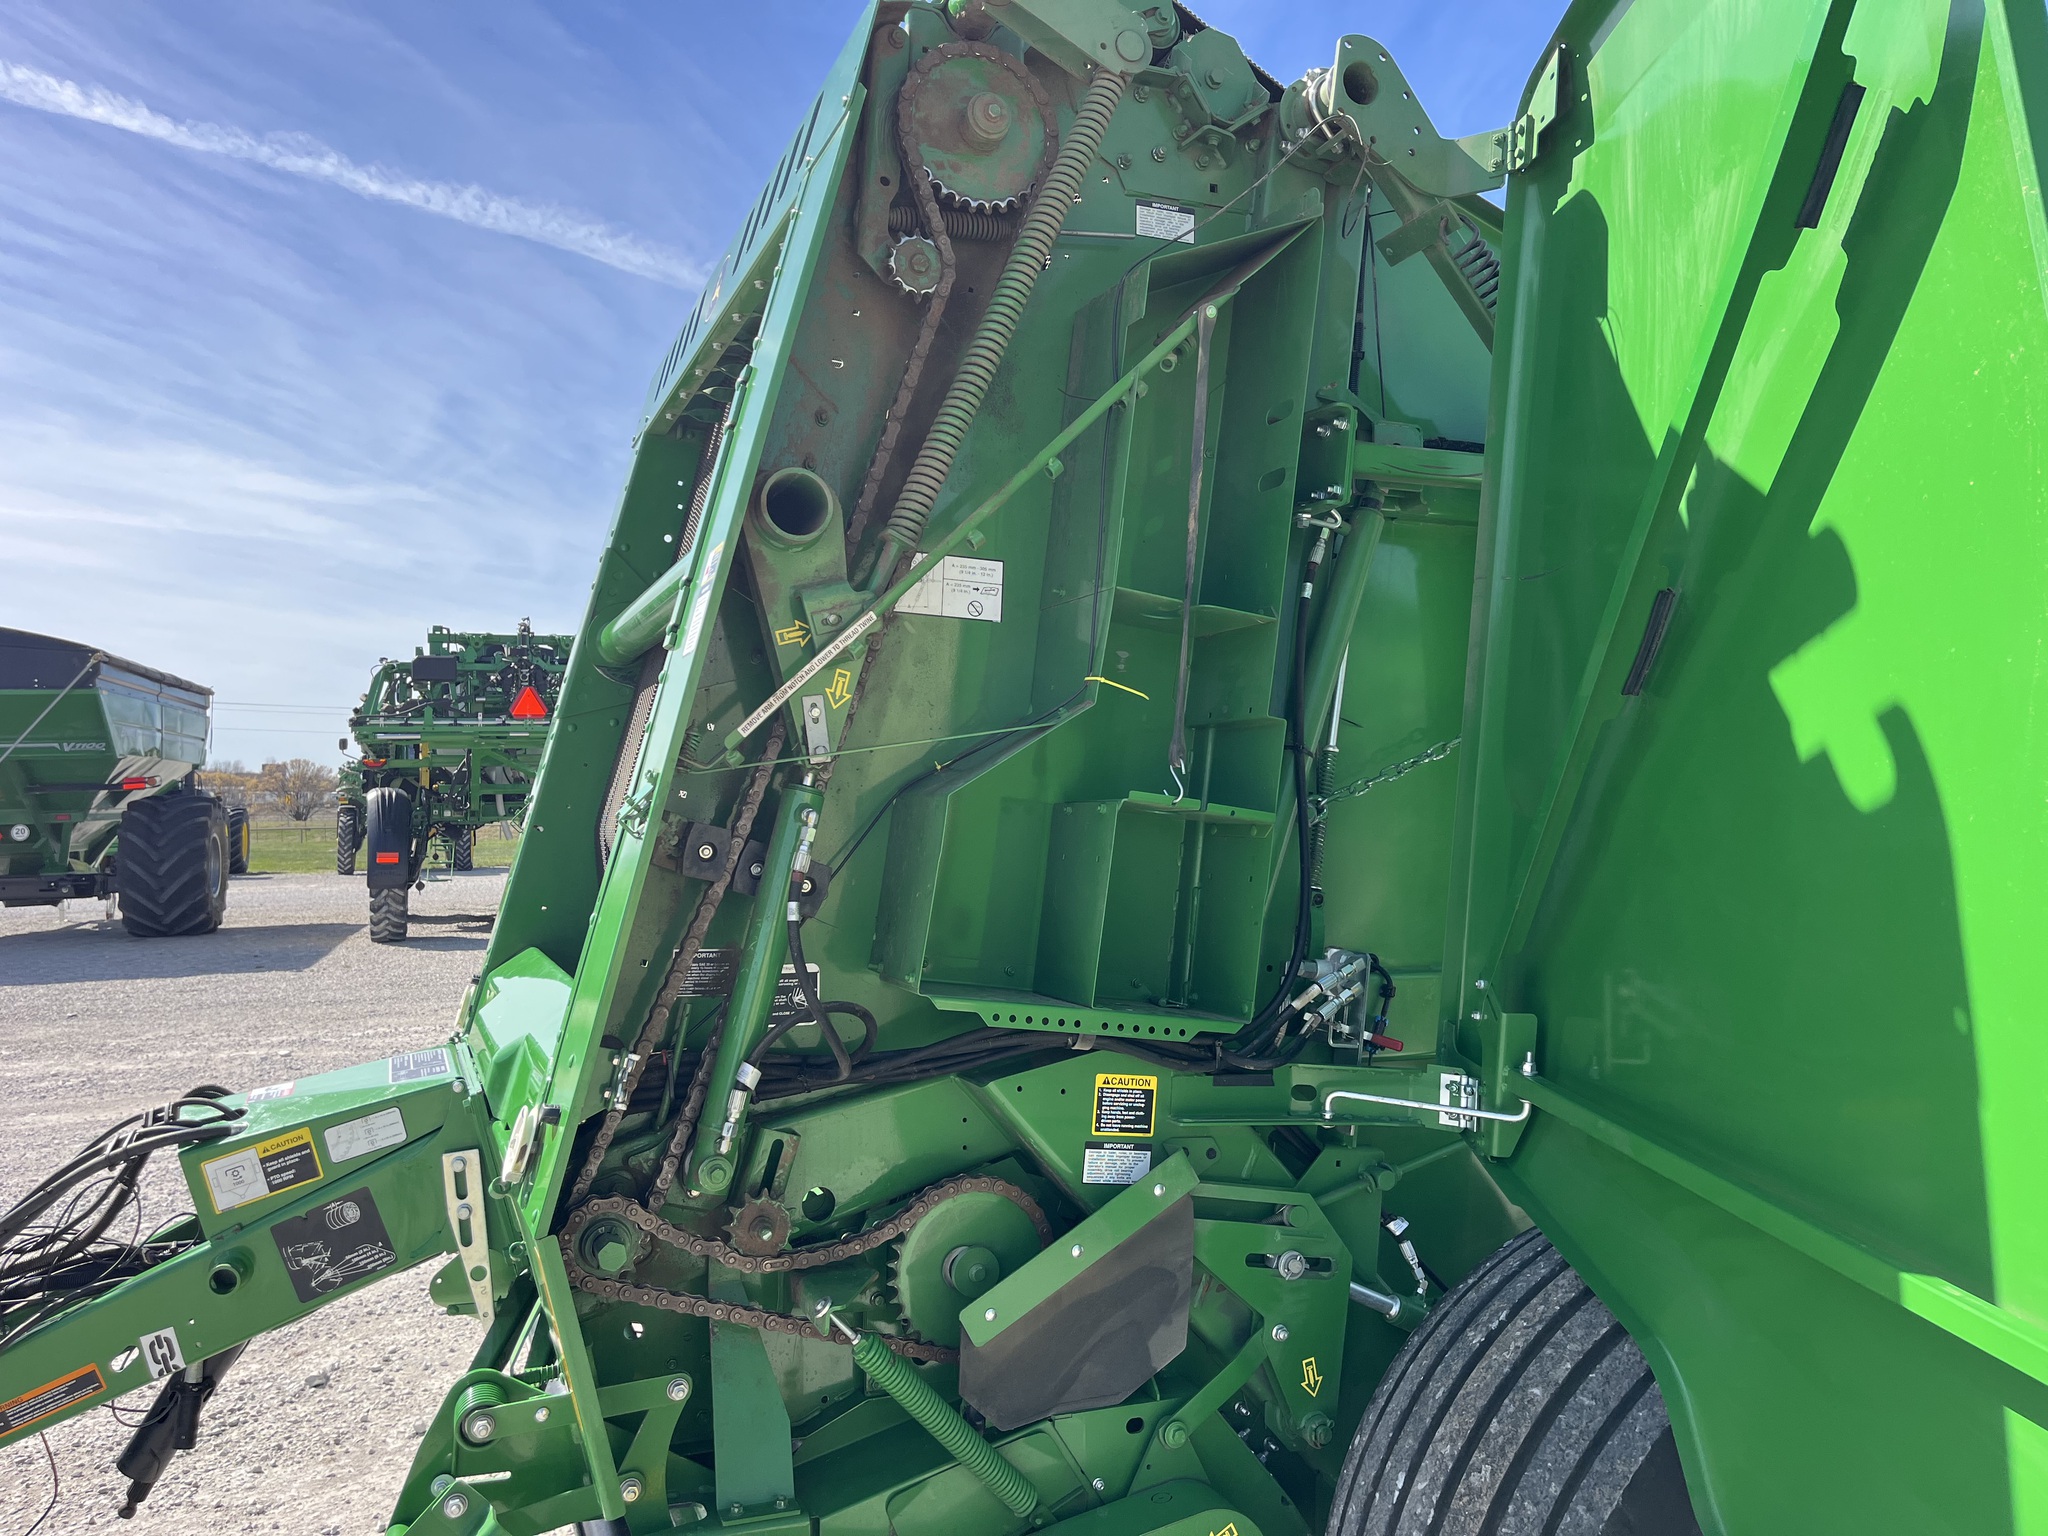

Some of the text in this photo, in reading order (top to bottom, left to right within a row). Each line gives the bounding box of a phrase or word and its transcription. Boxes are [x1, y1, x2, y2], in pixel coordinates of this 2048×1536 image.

[1152, 202, 1180, 211] IMPORTANT
[741, 614, 875, 733] REMOVE ARM FROM NOTCH AND LOWER TO THREAD TWINE
[1111, 1077, 1151, 1087] CAUTION
[270, 1134, 304, 1150] CAUTION
